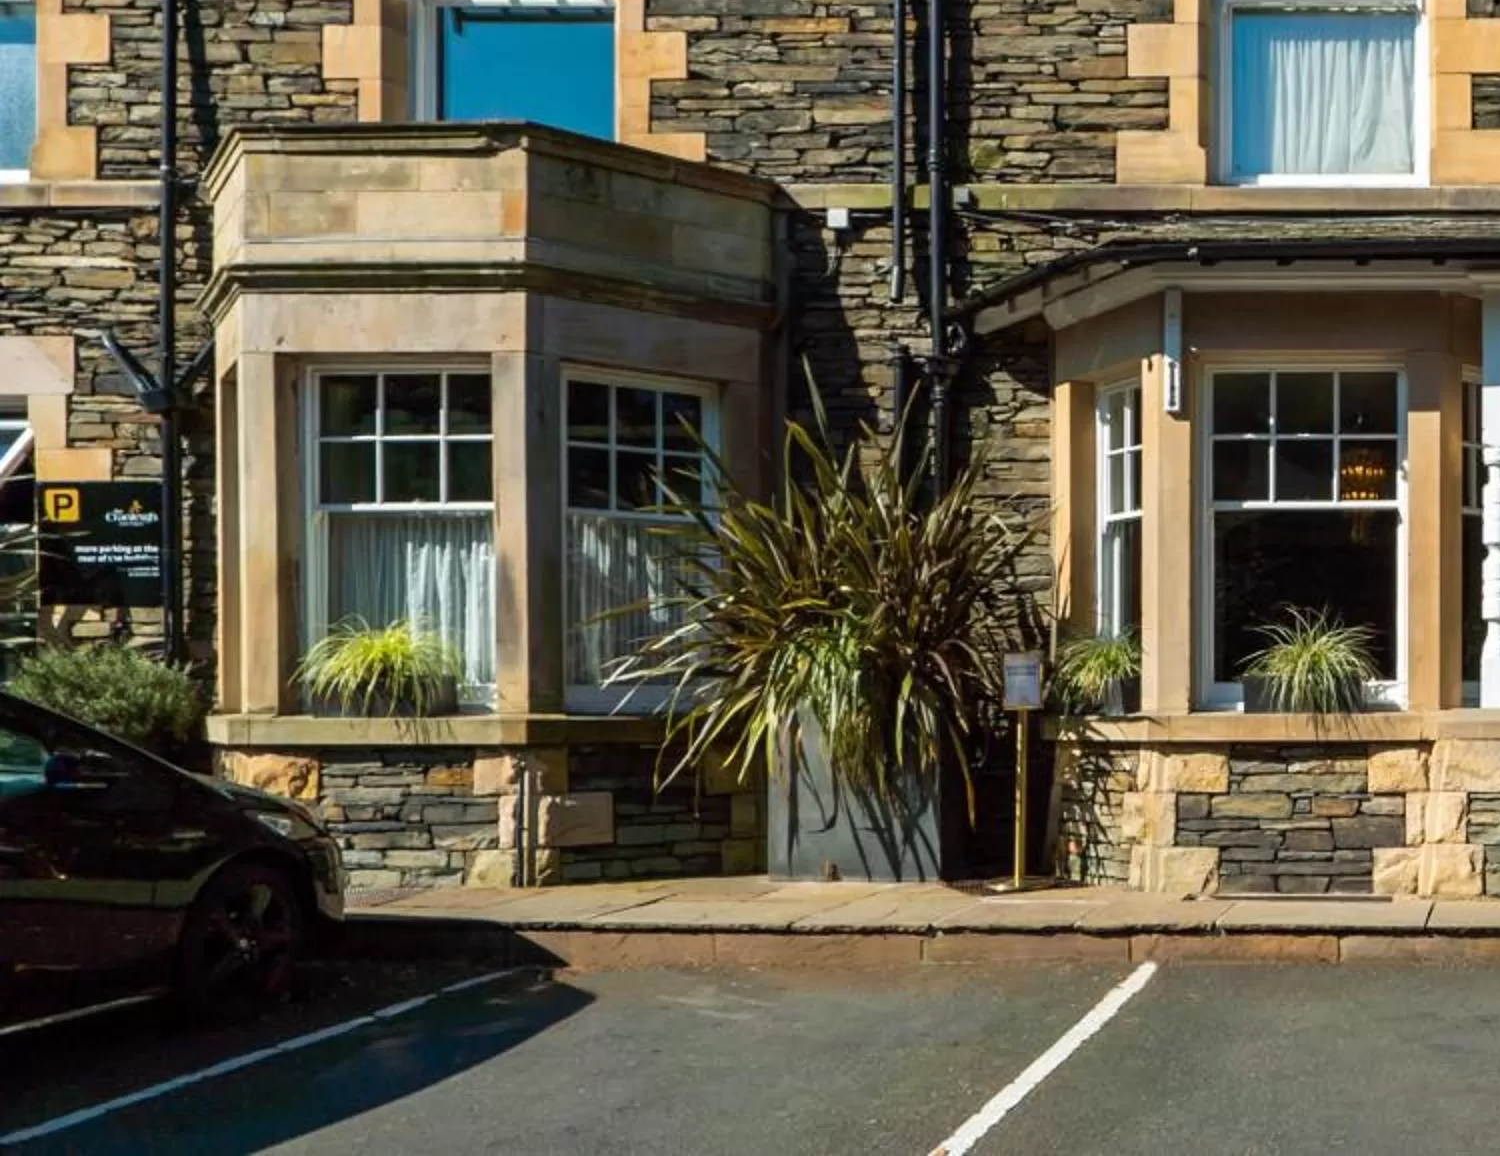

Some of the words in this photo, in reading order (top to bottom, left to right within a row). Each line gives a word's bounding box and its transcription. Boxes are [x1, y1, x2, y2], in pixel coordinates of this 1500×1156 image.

[53, 493, 73, 519] P
[99, 544, 132, 555] parking
[143, 544, 160, 553] the
